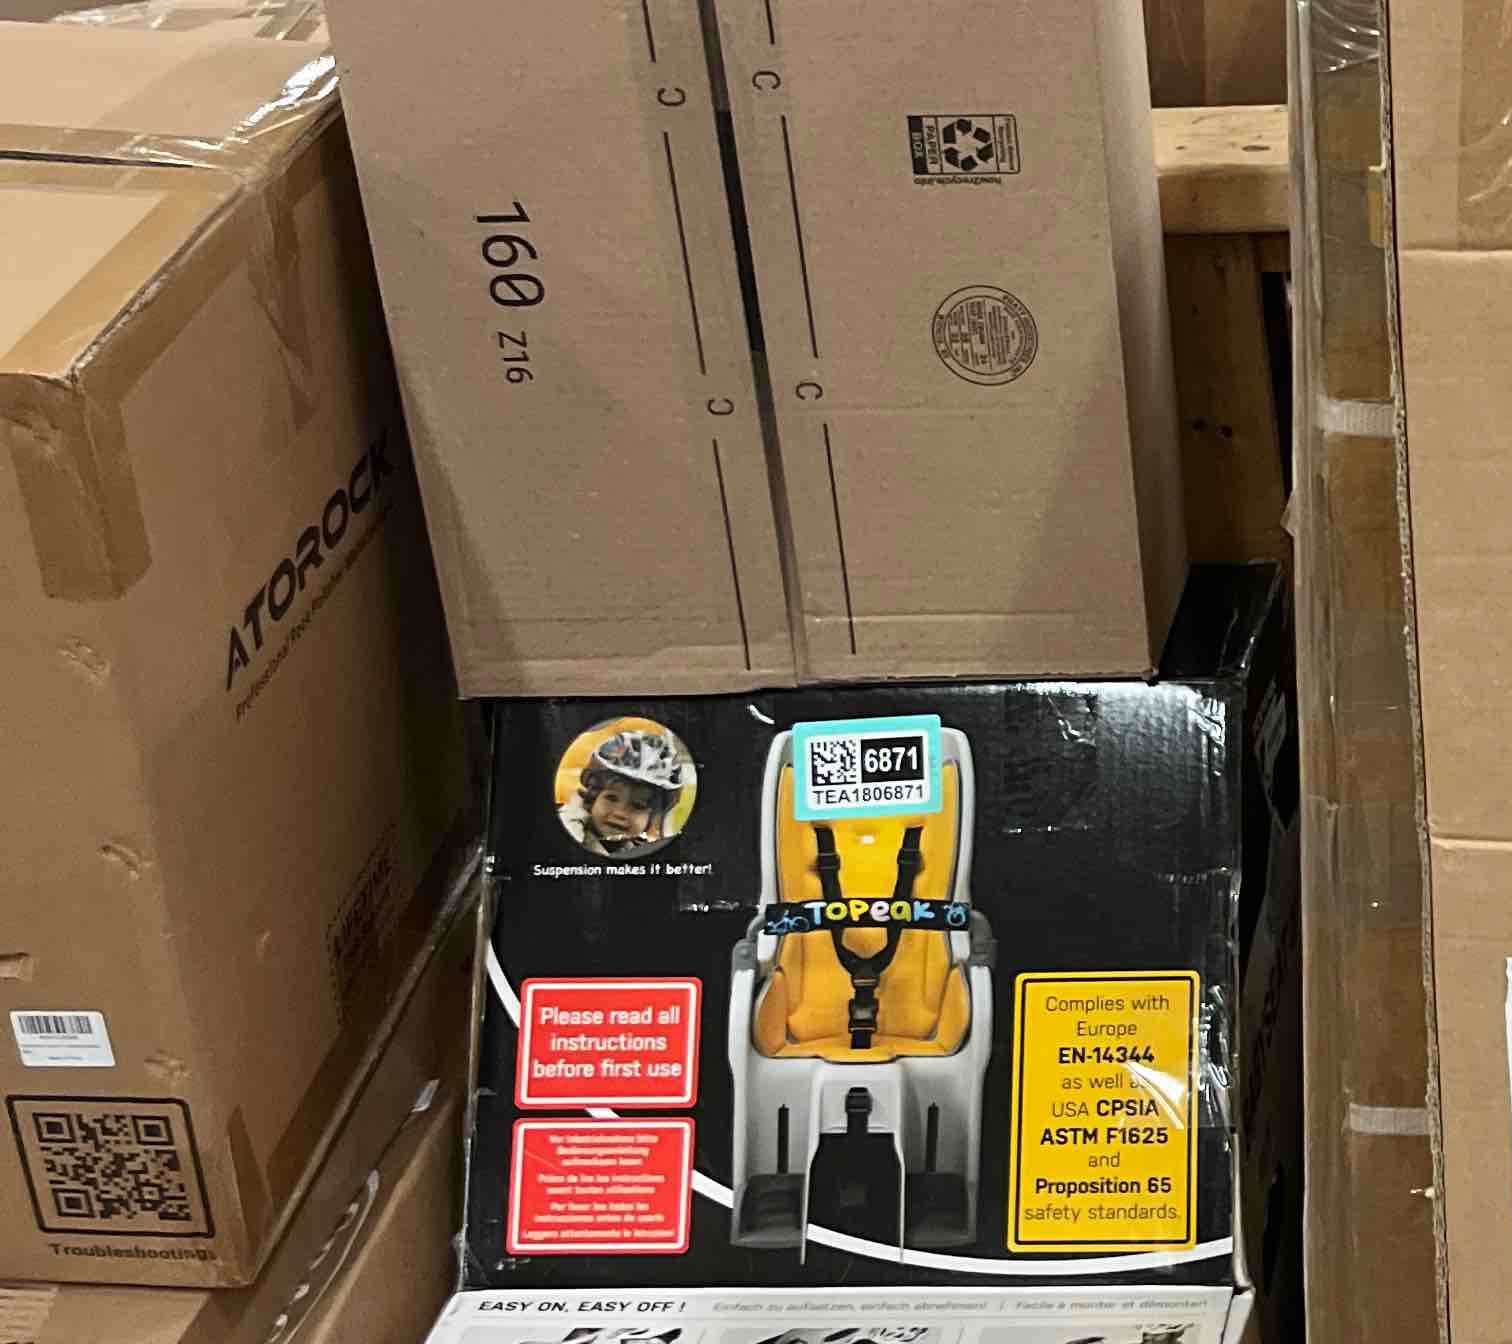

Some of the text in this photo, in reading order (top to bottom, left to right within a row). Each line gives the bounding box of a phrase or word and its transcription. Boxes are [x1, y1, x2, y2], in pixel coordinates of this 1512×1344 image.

[925, 124, 937, 166] PAPER
[475, 201, 545, 308] 160
[496, 329, 534, 385] Z16
[863, 747, 918, 773] 6871
[813, 785, 924, 804] TEA1806871
[533, 862, 712, 877] Suspension makes it better!
[1045, 994, 1170, 1014] Complies with
[540, 1005, 680, 1025] Please read all
[1076, 1020, 1137, 1039] Europe
[551, 1032, 667, 1051] instructions
[1058, 1045, 1155, 1064] EN-14344
[533, 1058, 682, 1078] before first use
[1061, 1076, 1082, 1090] as
[1089, 1072, 1123, 1090] well
[1051, 1099, 1160, 1118] USA CPSIA
[1040, 1127, 1169, 1145] ASTM F1625
[1088, 1152, 1121, 1168] and
[1035, 1177, 1172, 1198] Proposition 65
[1024, 1203, 1081, 1223] safety
[478, 1300, 533, 1312] EASY
[537, 1300, 569, 1313] ON,
[577, 1300, 632, 1312] EASY
[637, 1300, 675, 1312] OFF
